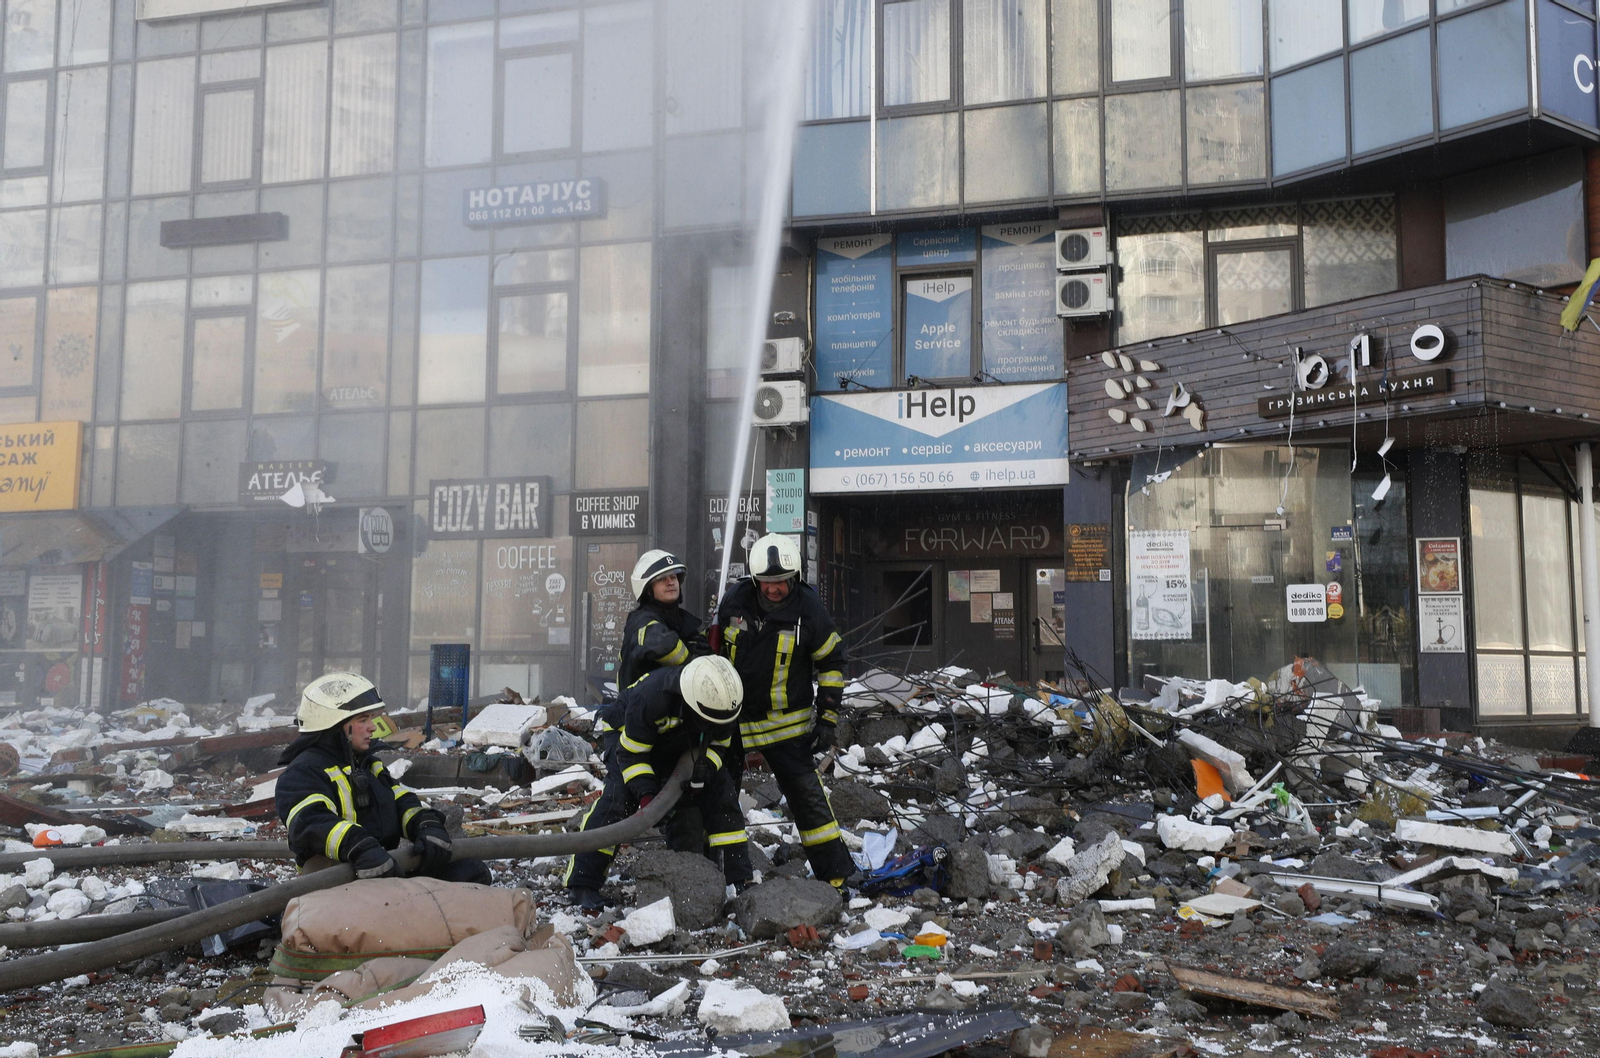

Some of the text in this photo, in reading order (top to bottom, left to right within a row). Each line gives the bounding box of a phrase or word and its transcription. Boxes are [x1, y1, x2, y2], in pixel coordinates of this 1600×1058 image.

[469, 180, 591, 208] НОТАРІУС
[469, 211, 488, 221] 066
[492, 208, 511, 219] 112
[514, 206, 527, 217] 01
[531, 206, 545, 216] 00
[1000, 224, 1043, 236] РЕМОНТ
[833, 238, 873, 249] РЕМОНТ
[912, 235, 959, 246] Сервісний
[922, 249, 950, 258] центр
[998, 261, 1046, 273] прошивка
[831, 273, 877, 284] мобільних
[831, 282, 875, 293] телефонів
[922, 280, 956, 296] iHelp
[994, 289, 1050, 299] заміна скла
[827, 310, 881, 322] комп'ютерів
[921, 323, 956, 335] Apple
[984, 318, 1017, 329] ремонт
[997, 325, 1047, 337] складності
[831, 338, 877, 350] планшетів
[914, 338, 961, 350] Service
[997, 354, 1048, 366] програмне
[833, 367, 875, 379] ноутбуків
[990, 364, 1055, 375] забезпечення
[330, 386, 375, 400] АТЕЛЬЄ
[1268, 386, 1369, 410] ГРУЗИНСЬКА
[897, 388, 976, 423] iHelp
[0, 429, 55, 448] ЬКИЙ
[843, 439, 1042, 460] ремонт сервіс аксесуари
[257, 462, 313, 470] MASTER
[776, 472, 796, 482] SLIM
[855, 467, 1036, 488] (067) 156 50 66 ihelp.ua
[775, 488, 803, 498] STUDIO
[432, 481, 540, 532] COZY BAR
[576, 495, 640, 512] COFFEE SHOP
[709, 497, 760, 513] COZ BAR
[581, 513, 636, 529] & YUMMIES
[709, 514, 721, 522] True
[744, 513, 762, 522] Coffee
[938, 513, 961, 522] GYM
[975, 511, 1016, 521] FITNESS
[905, 525, 1050, 551] FORWARD
[497, 545, 556, 570] COFFEE
[666, 556, 674, 565] 8
[1166, 579, 1187, 589] 15%
[1291, 591, 1322, 599] dediko
[994, 617, 1015, 625] АТЕЛЬЄ
